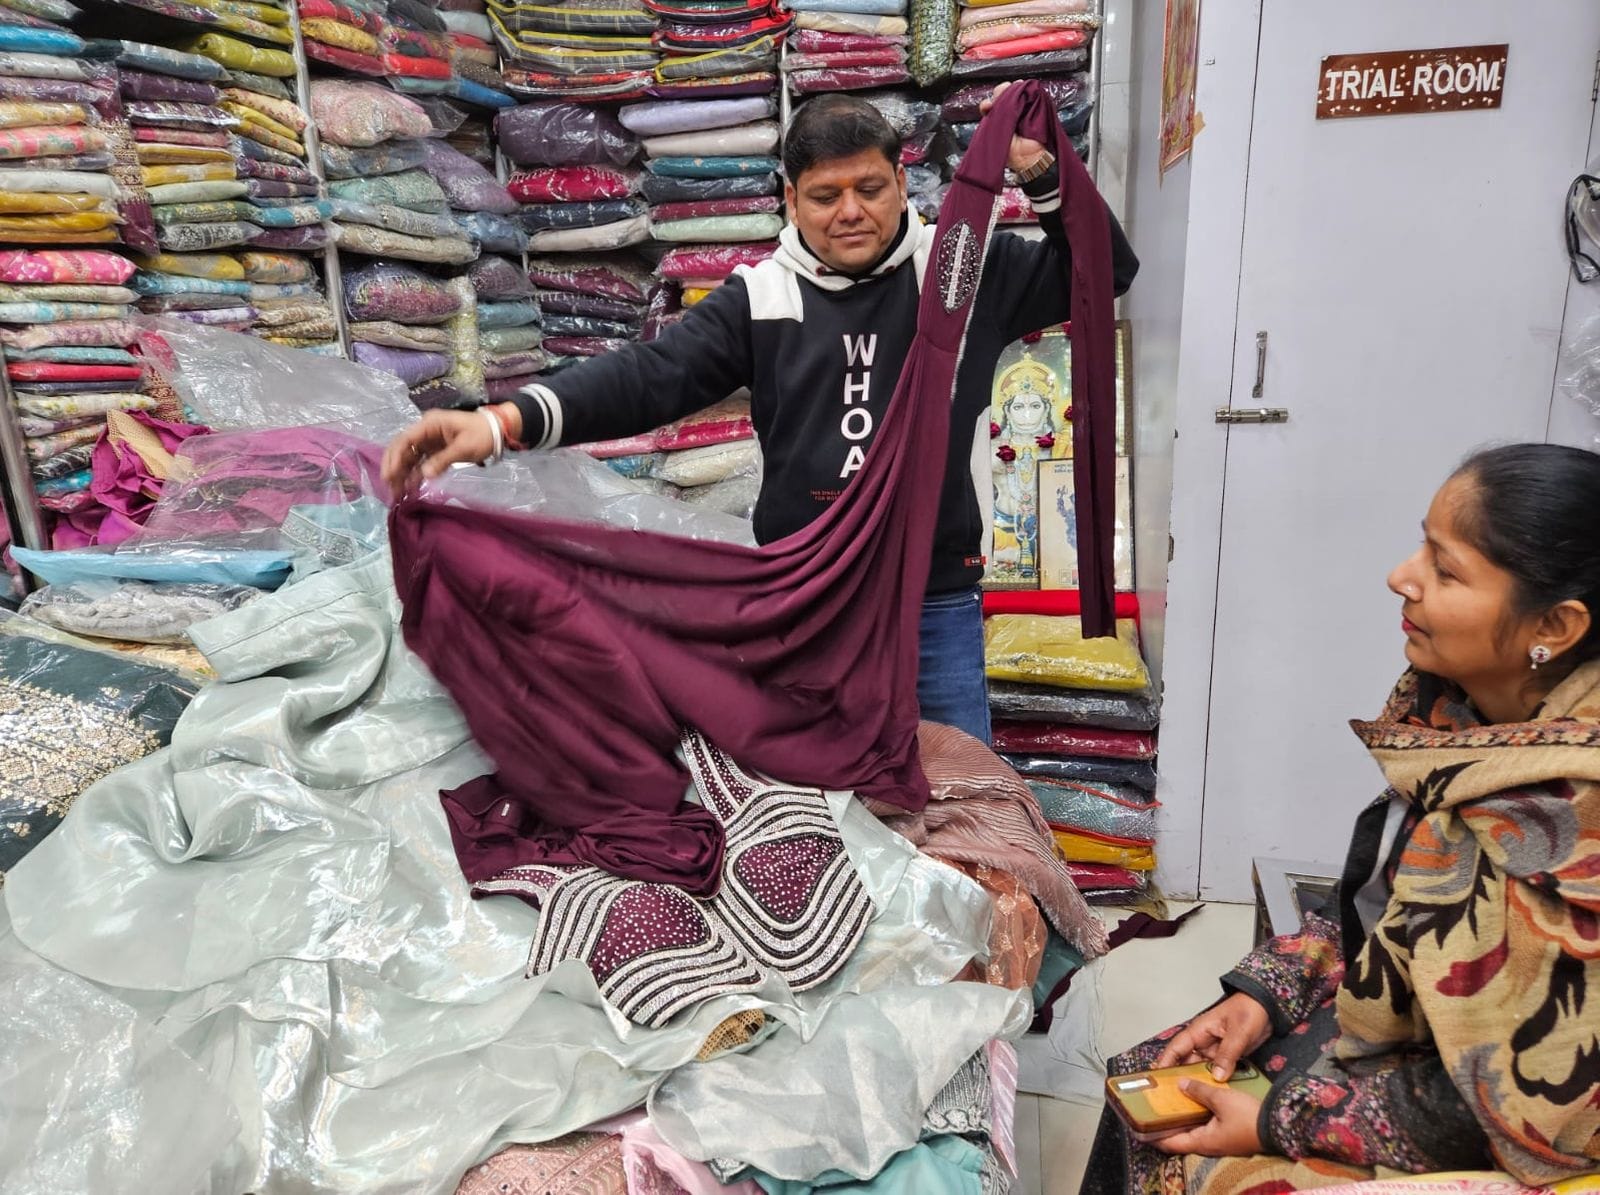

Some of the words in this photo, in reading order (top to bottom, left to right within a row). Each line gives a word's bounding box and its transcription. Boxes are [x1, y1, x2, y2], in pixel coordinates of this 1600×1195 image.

[1325, 68, 1404, 101] TRIAL
[1412, 61, 1501, 96] ROOM
[839, 334, 878, 479] WHOA
